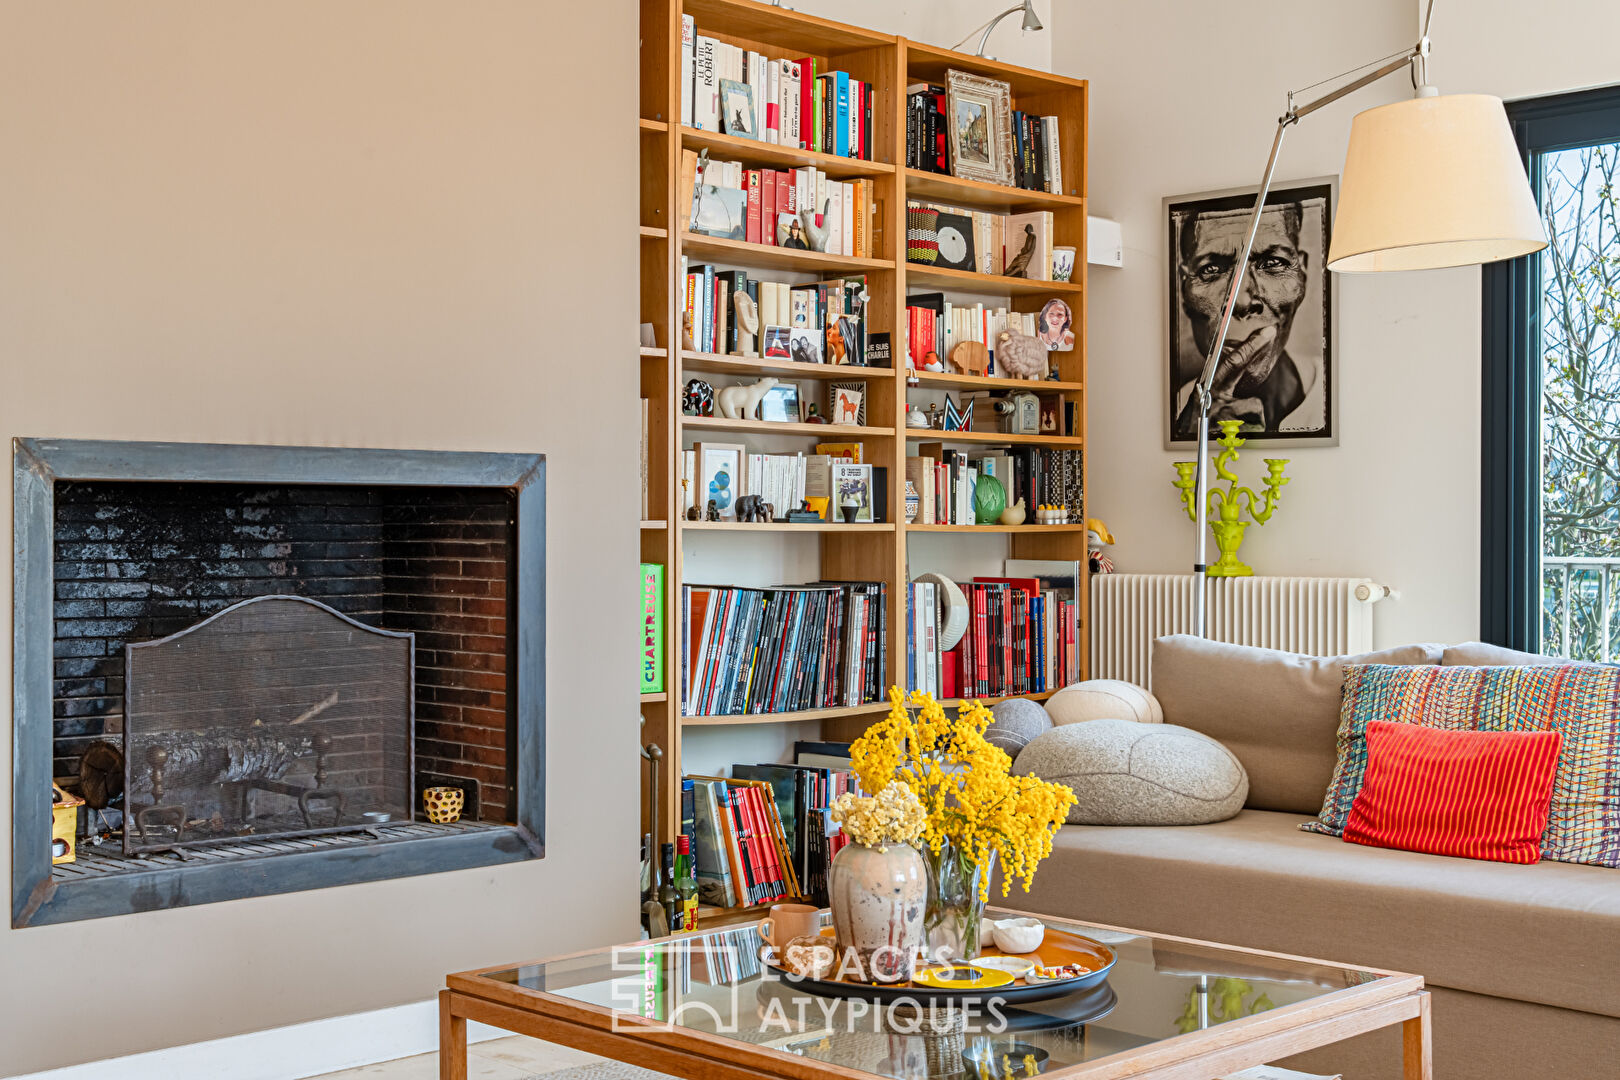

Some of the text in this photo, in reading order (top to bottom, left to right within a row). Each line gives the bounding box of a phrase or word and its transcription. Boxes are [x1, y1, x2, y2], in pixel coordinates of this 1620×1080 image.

[697, 46, 705, 79] LE PETIT
[704, 40, 713, 87] ROBERT
[788, 185, 796, 211] PANIQUE
[867, 350, 890, 360] CHARLIE
[876, 343, 889, 351] SUIS
[645, 574, 655, 682] CHARTREUSE
